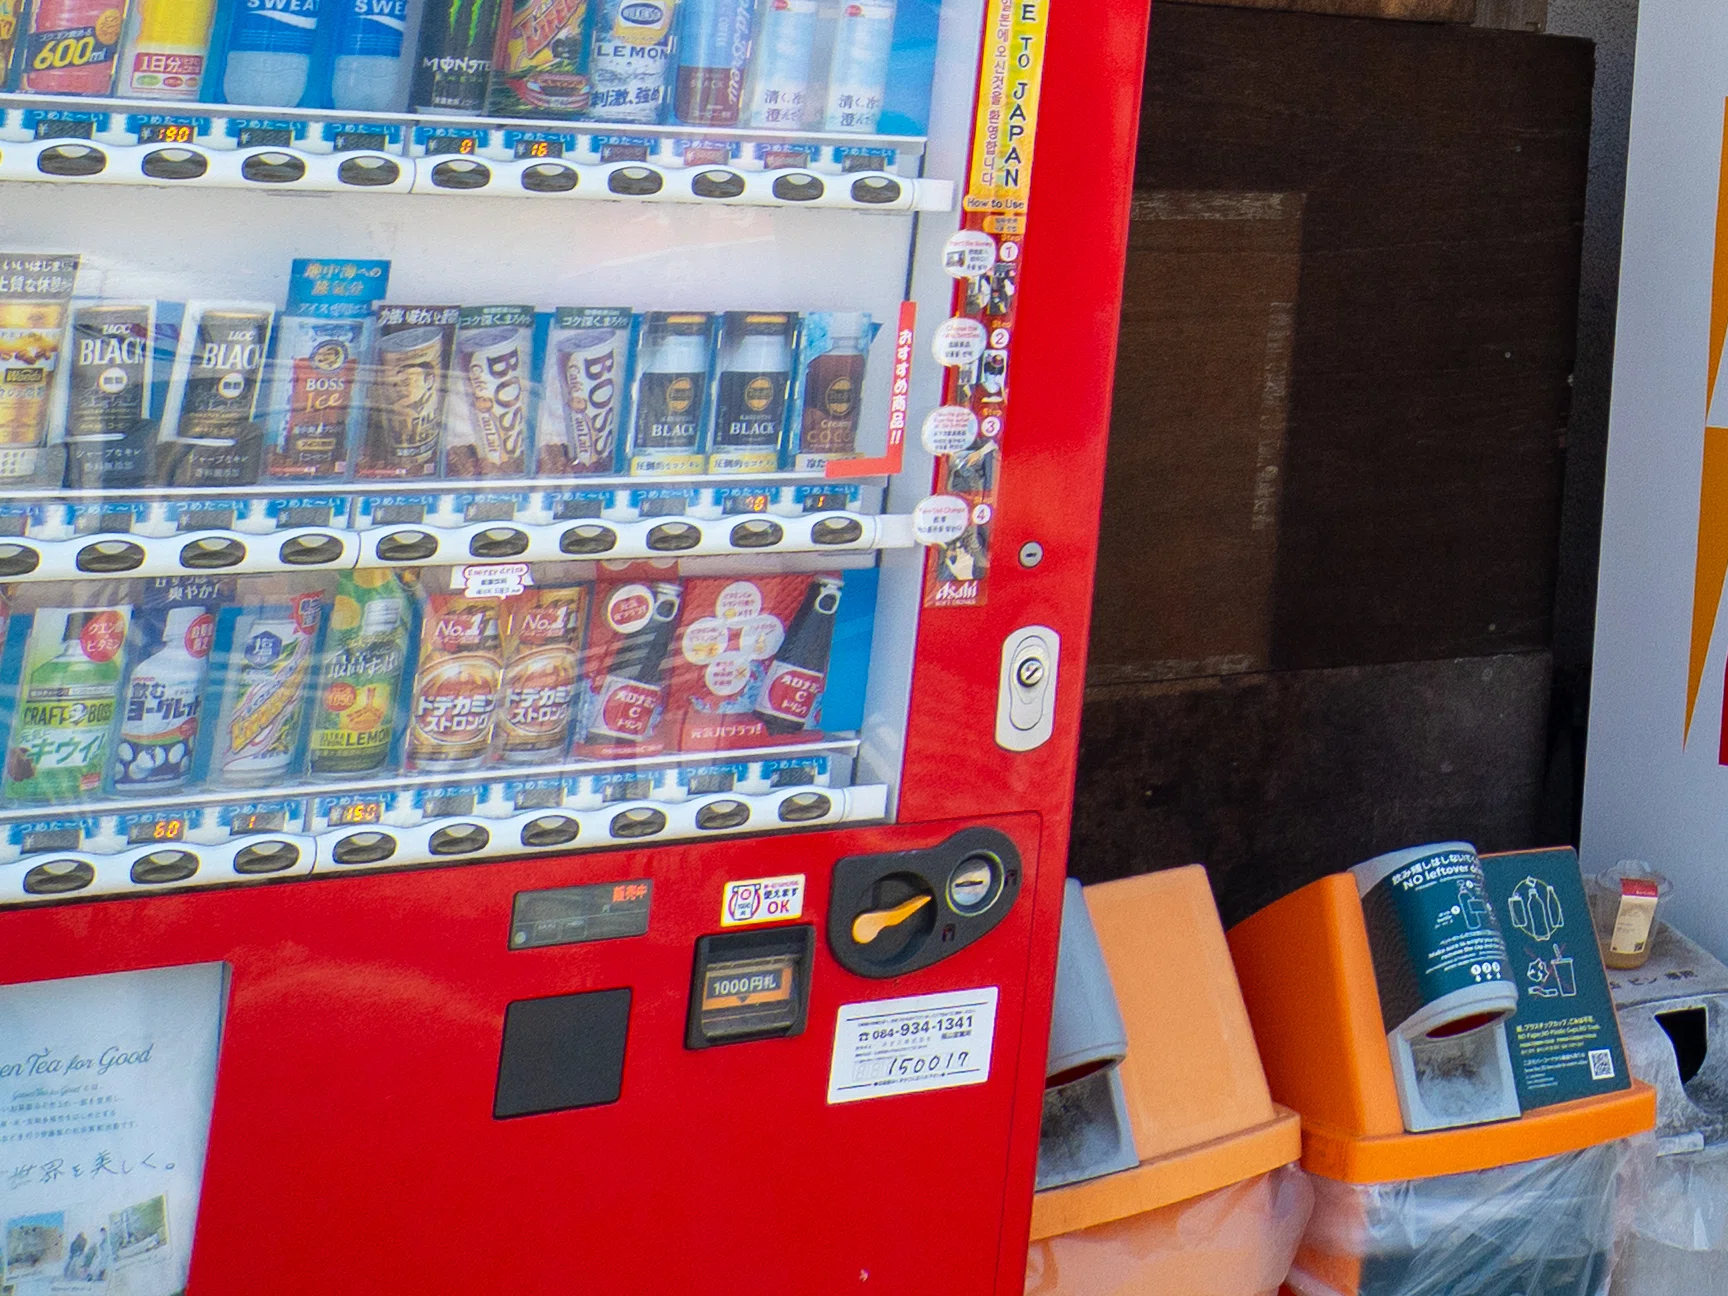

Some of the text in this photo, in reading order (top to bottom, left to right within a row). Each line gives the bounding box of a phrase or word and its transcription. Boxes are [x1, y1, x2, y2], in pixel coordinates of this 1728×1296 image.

[1018, 36, 1031, 68] TO
[1003, 82, 1029, 188] JAPAN
[80, 338, 147, 366] BLACK
[305, 376, 345, 391] BOSS
[305, 391, 344, 412] Ice
[486, 348, 524, 458] BOSS
[584, 350, 616, 456] BOSS
[651, 422, 695, 437] BLACK
[729, 421, 775, 436] BLACK
[935, 580, 978, 601] Asahi
[434, 611, 485, 637] No.1
[521, 604, 569, 630] No.1
[22, 704, 69, 726] CRAFT
[1402, 864, 1469, 891] NO leftover
[611, 883, 648, 904] 販売中
[763, 886, 800, 902] 使えます
[766, 900, 791, 915] OK
[713, 973, 777, 996] 1000円札
[872, 1015, 974, 1041] 084-934-1341
[27, 1047, 63, 1076] Tea
[63, 1054, 94, 1076] for
[97, 1043, 155, 1075] Good
